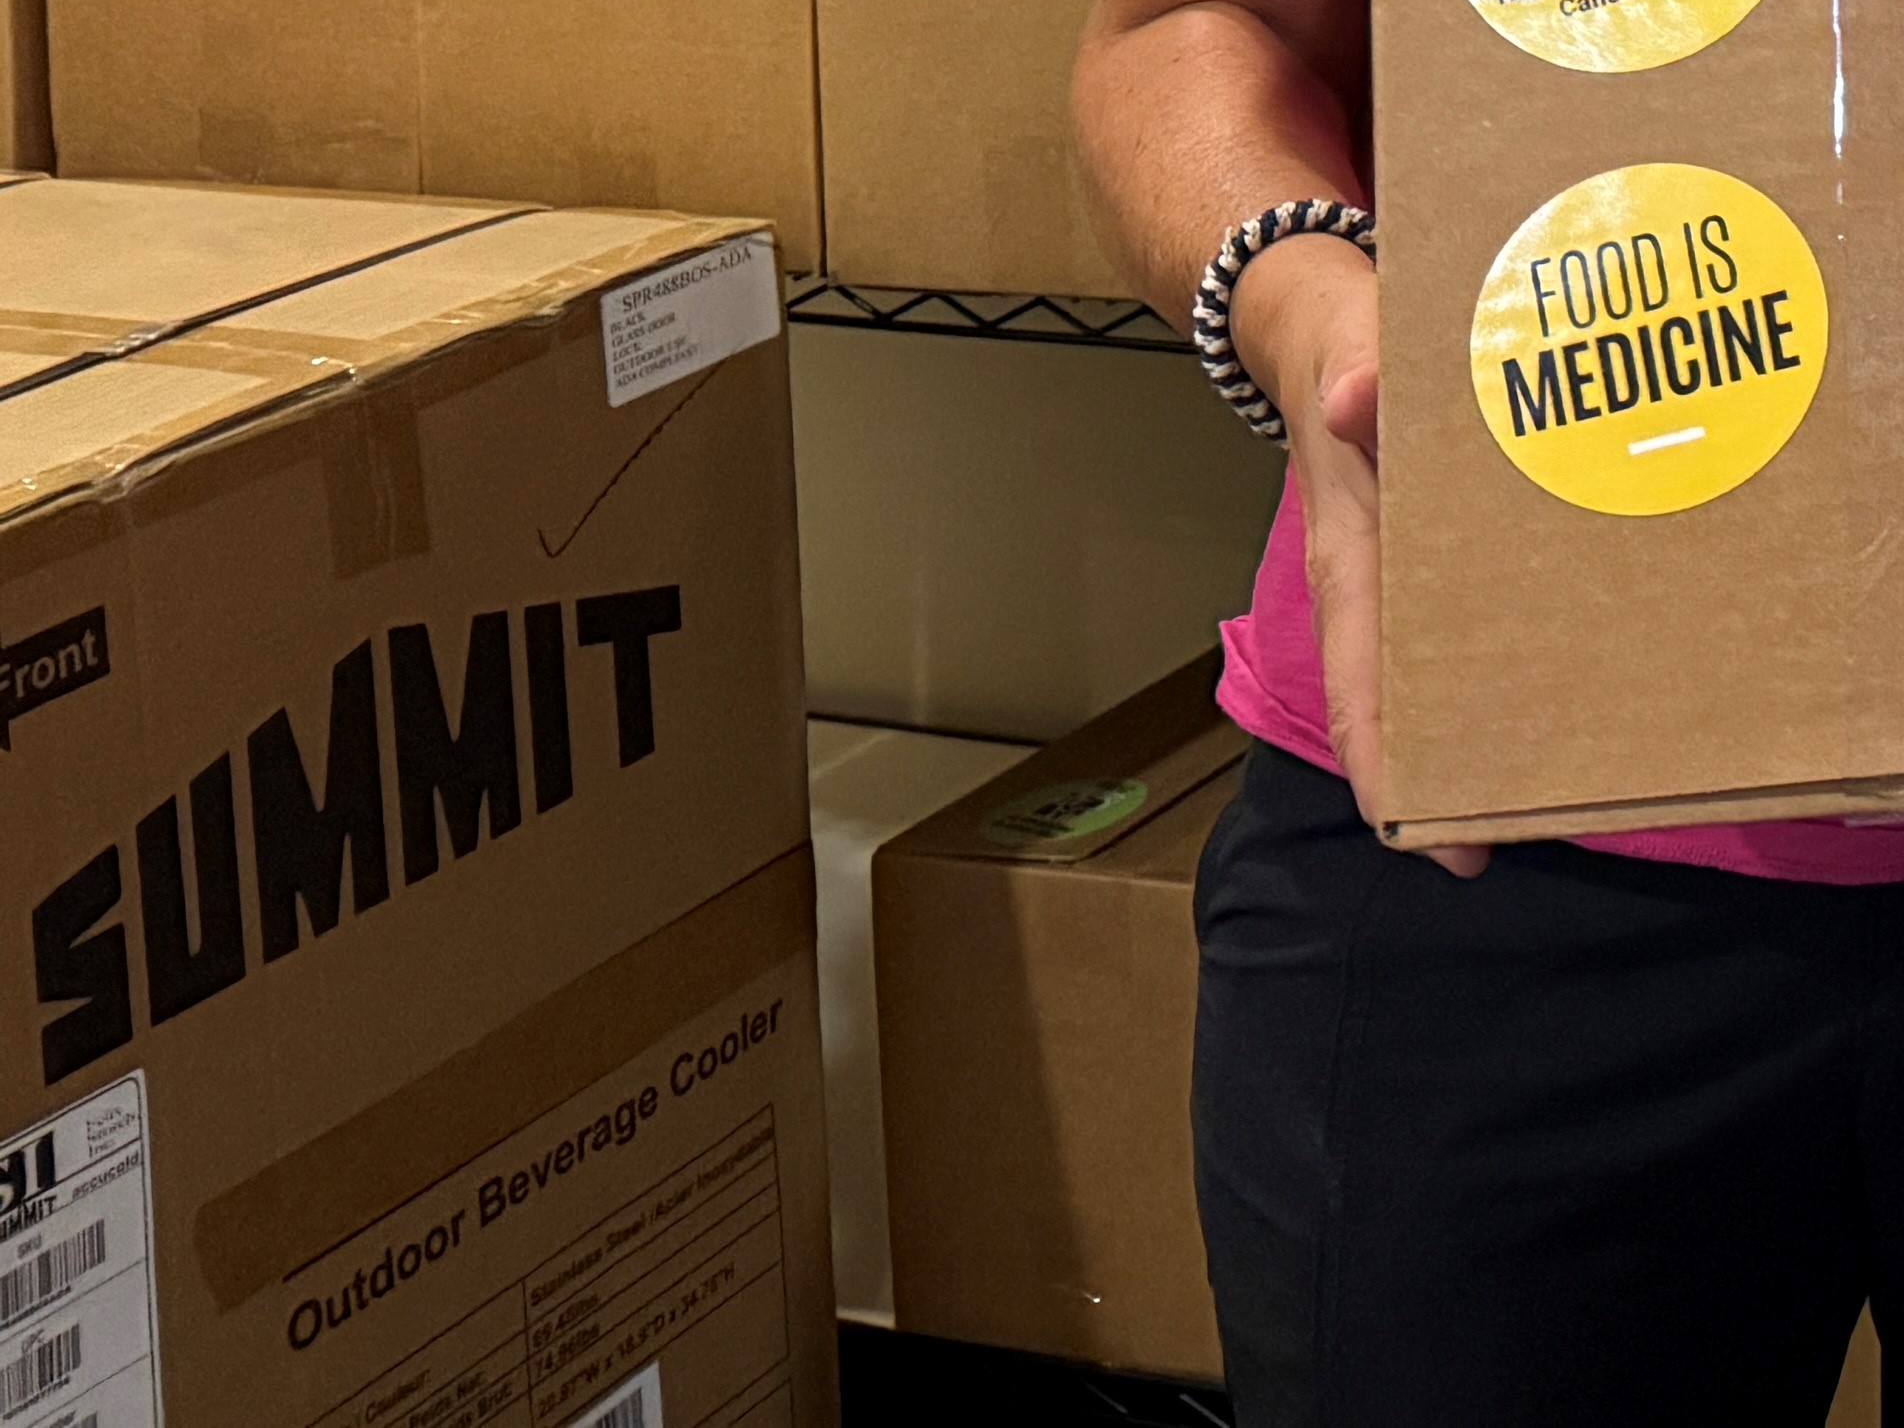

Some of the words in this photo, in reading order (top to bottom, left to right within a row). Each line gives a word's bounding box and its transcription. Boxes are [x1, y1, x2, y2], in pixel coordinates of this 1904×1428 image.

[1502, 289, 1800, 438] MEDICINE
[1529, 231, 1669, 337] FOOD
[1683, 214, 1738, 300] IS
[32, 584, 683, 1087] SUMMIT
[287, 1209, 466, 1351] Outdoor
[477, 1086, 659, 1228] Beverage
[669, 999, 784, 1098] Cooler
